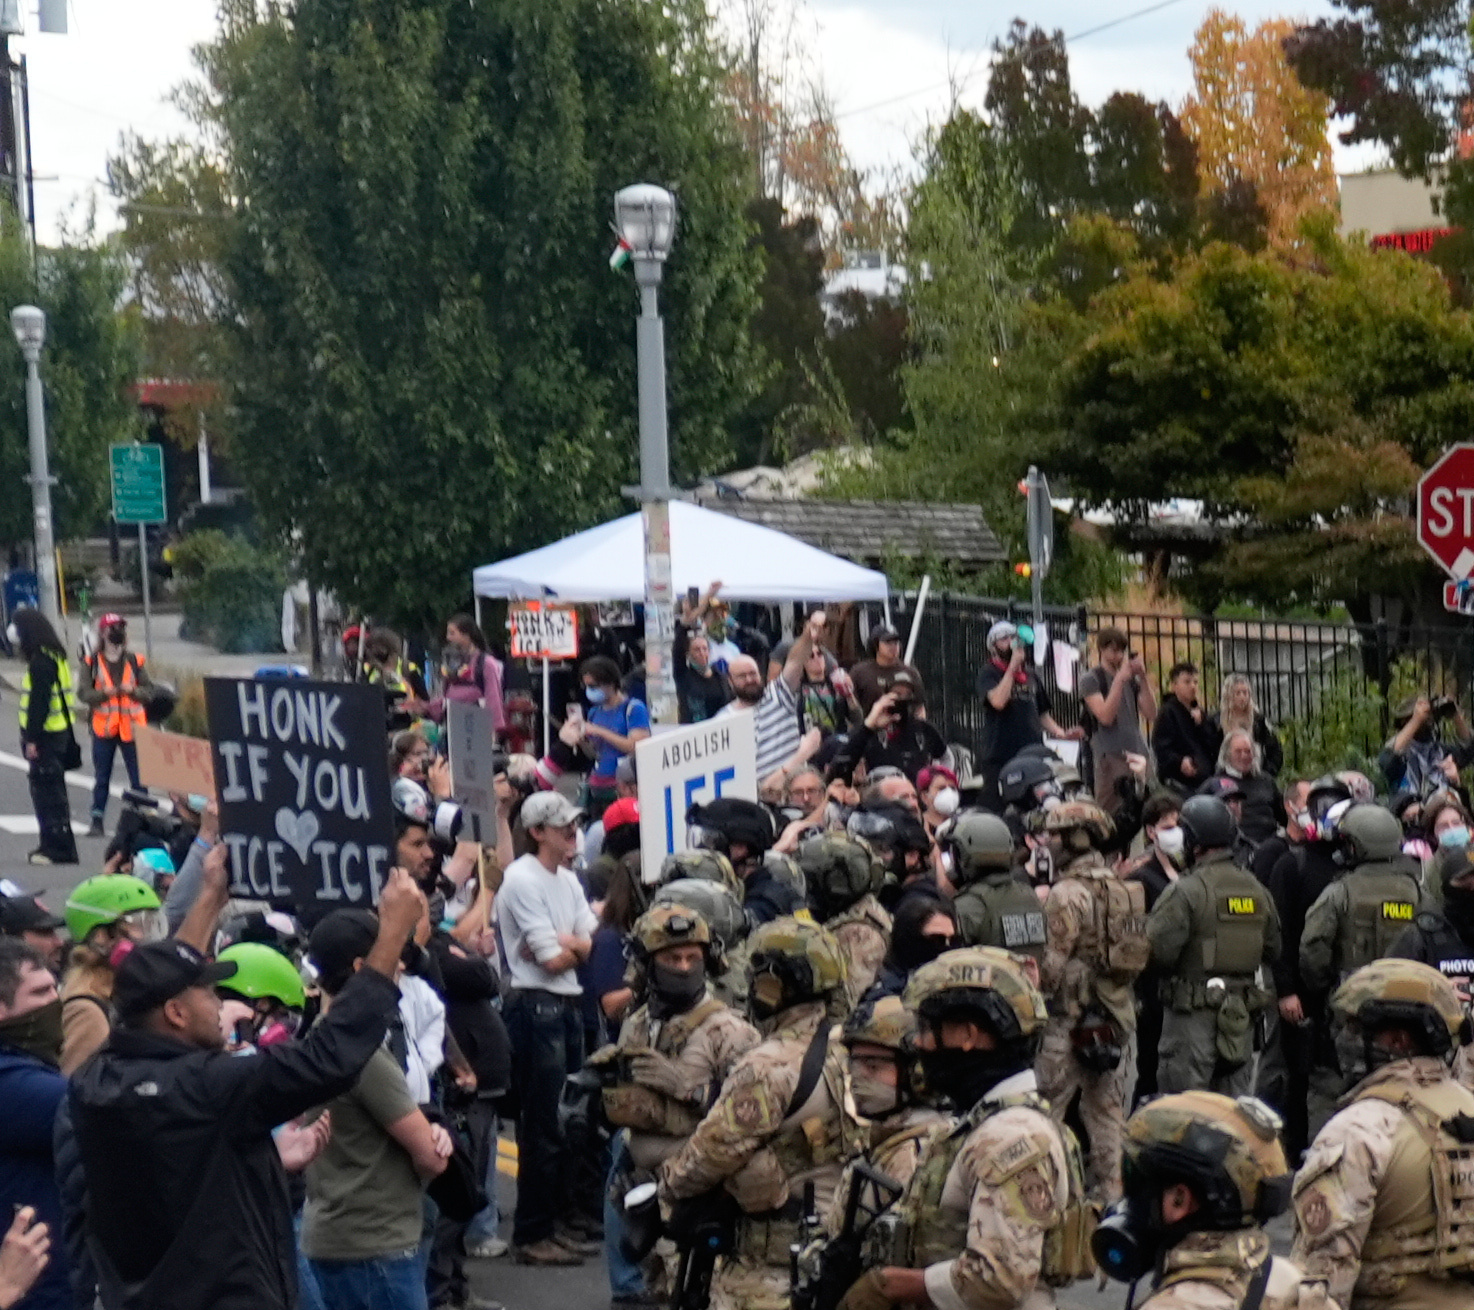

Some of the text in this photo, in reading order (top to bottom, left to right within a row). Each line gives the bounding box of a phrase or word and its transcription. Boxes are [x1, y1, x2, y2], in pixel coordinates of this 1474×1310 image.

[237, 681, 346, 750] HONK
[662, 726, 730, 771] ABOLISH
[219, 741, 371, 822] IF YOU
[222, 832, 291, 897] ICE
[1228, 898, 1254, 914] POLICE
[1383, 902, 1413, 920] POLICE
[950, 964, 987, 983] SRT
